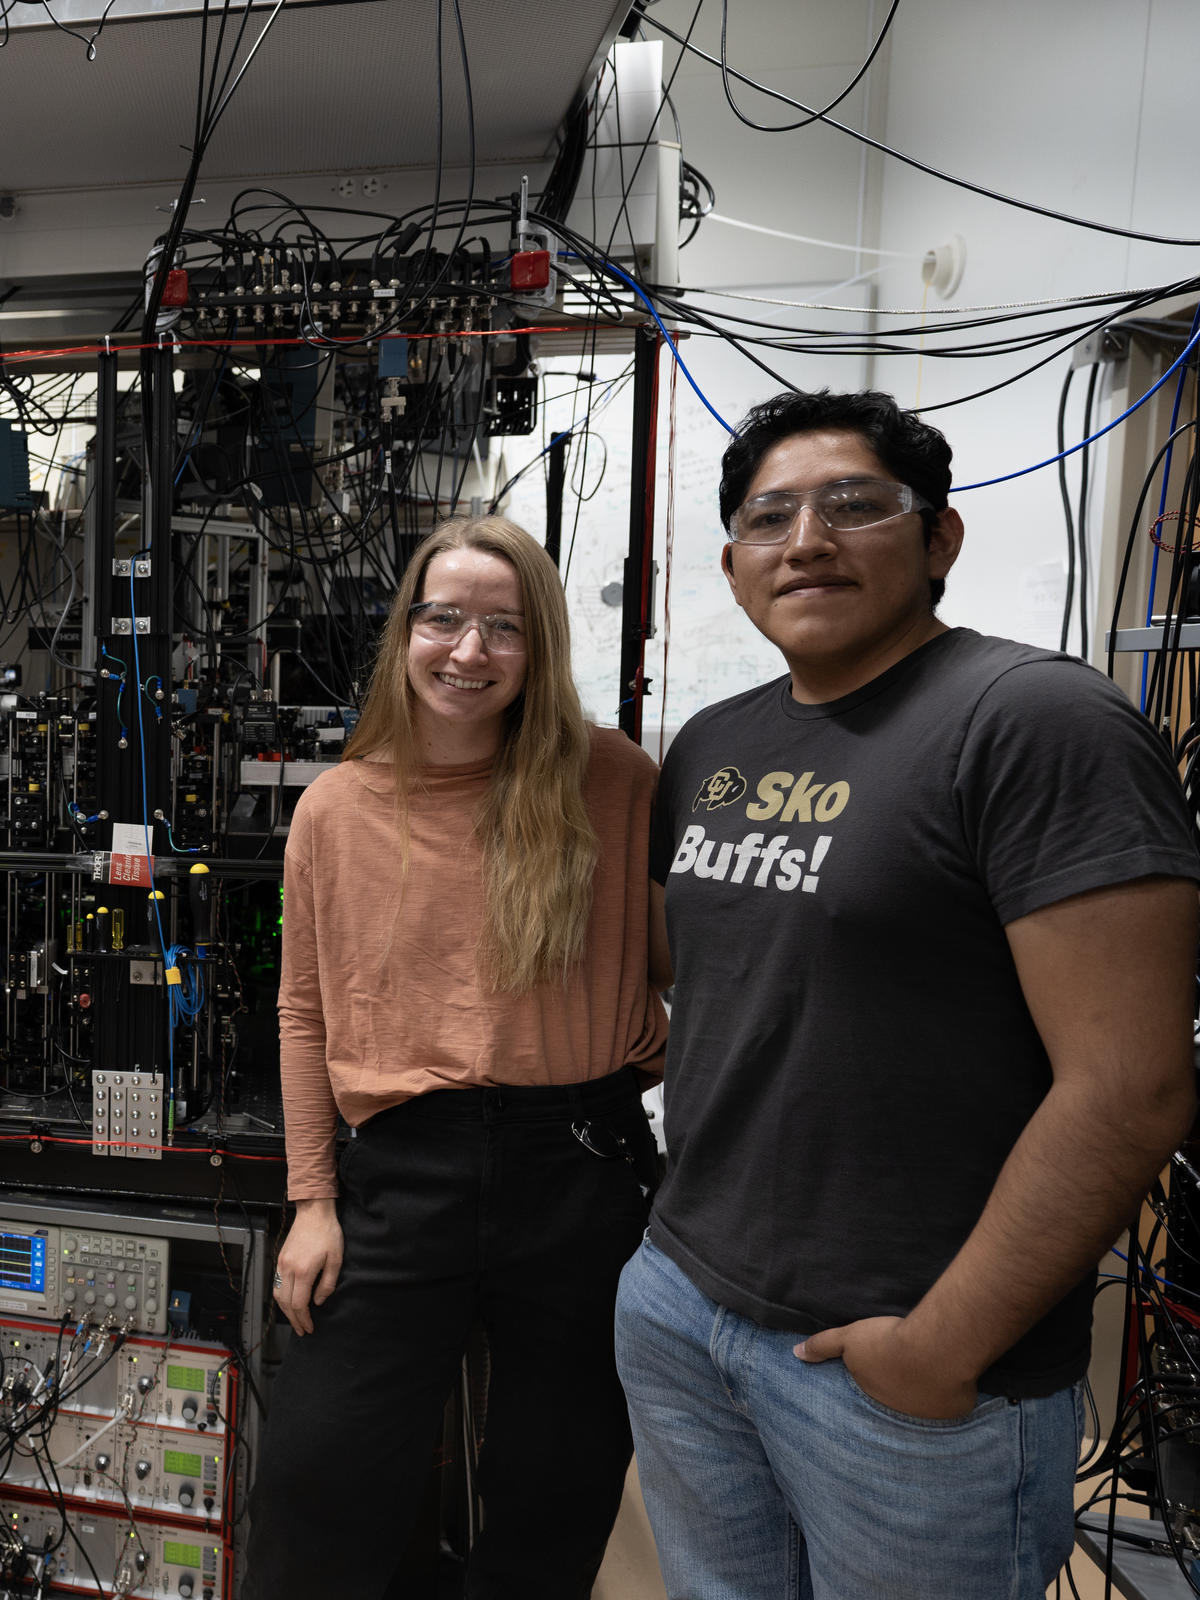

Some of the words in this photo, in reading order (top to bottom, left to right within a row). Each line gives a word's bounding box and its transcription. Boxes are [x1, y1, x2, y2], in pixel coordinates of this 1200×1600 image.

[745, 771, 850, 823] Sko
[113, 862, 123, 881] Lens
[131, 857, 141, 881] Tissue
[670, 825, 833, 893] Buffs!
